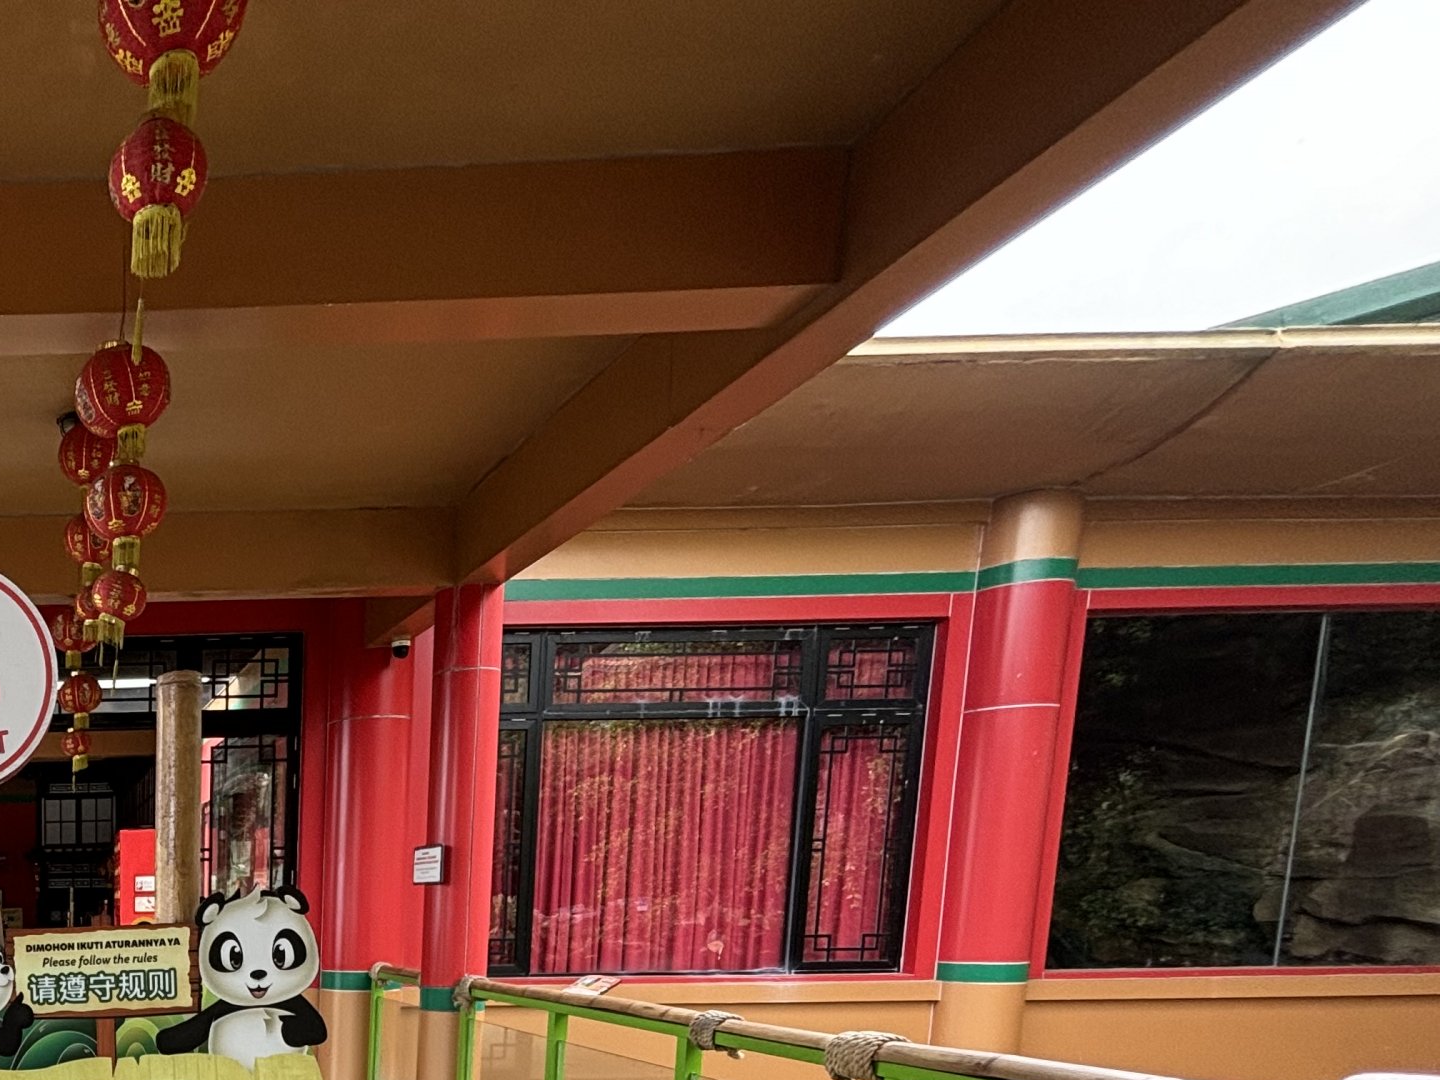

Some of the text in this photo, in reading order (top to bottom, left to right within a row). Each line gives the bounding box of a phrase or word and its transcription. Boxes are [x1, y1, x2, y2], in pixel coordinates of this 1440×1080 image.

[25, 937, 181, 953] DIMOHON IKUTI ATURANNYA YA
[42, 952, 159, 969] Please follow the rules
[28, 968, 177, 1005] 请遵守规则
